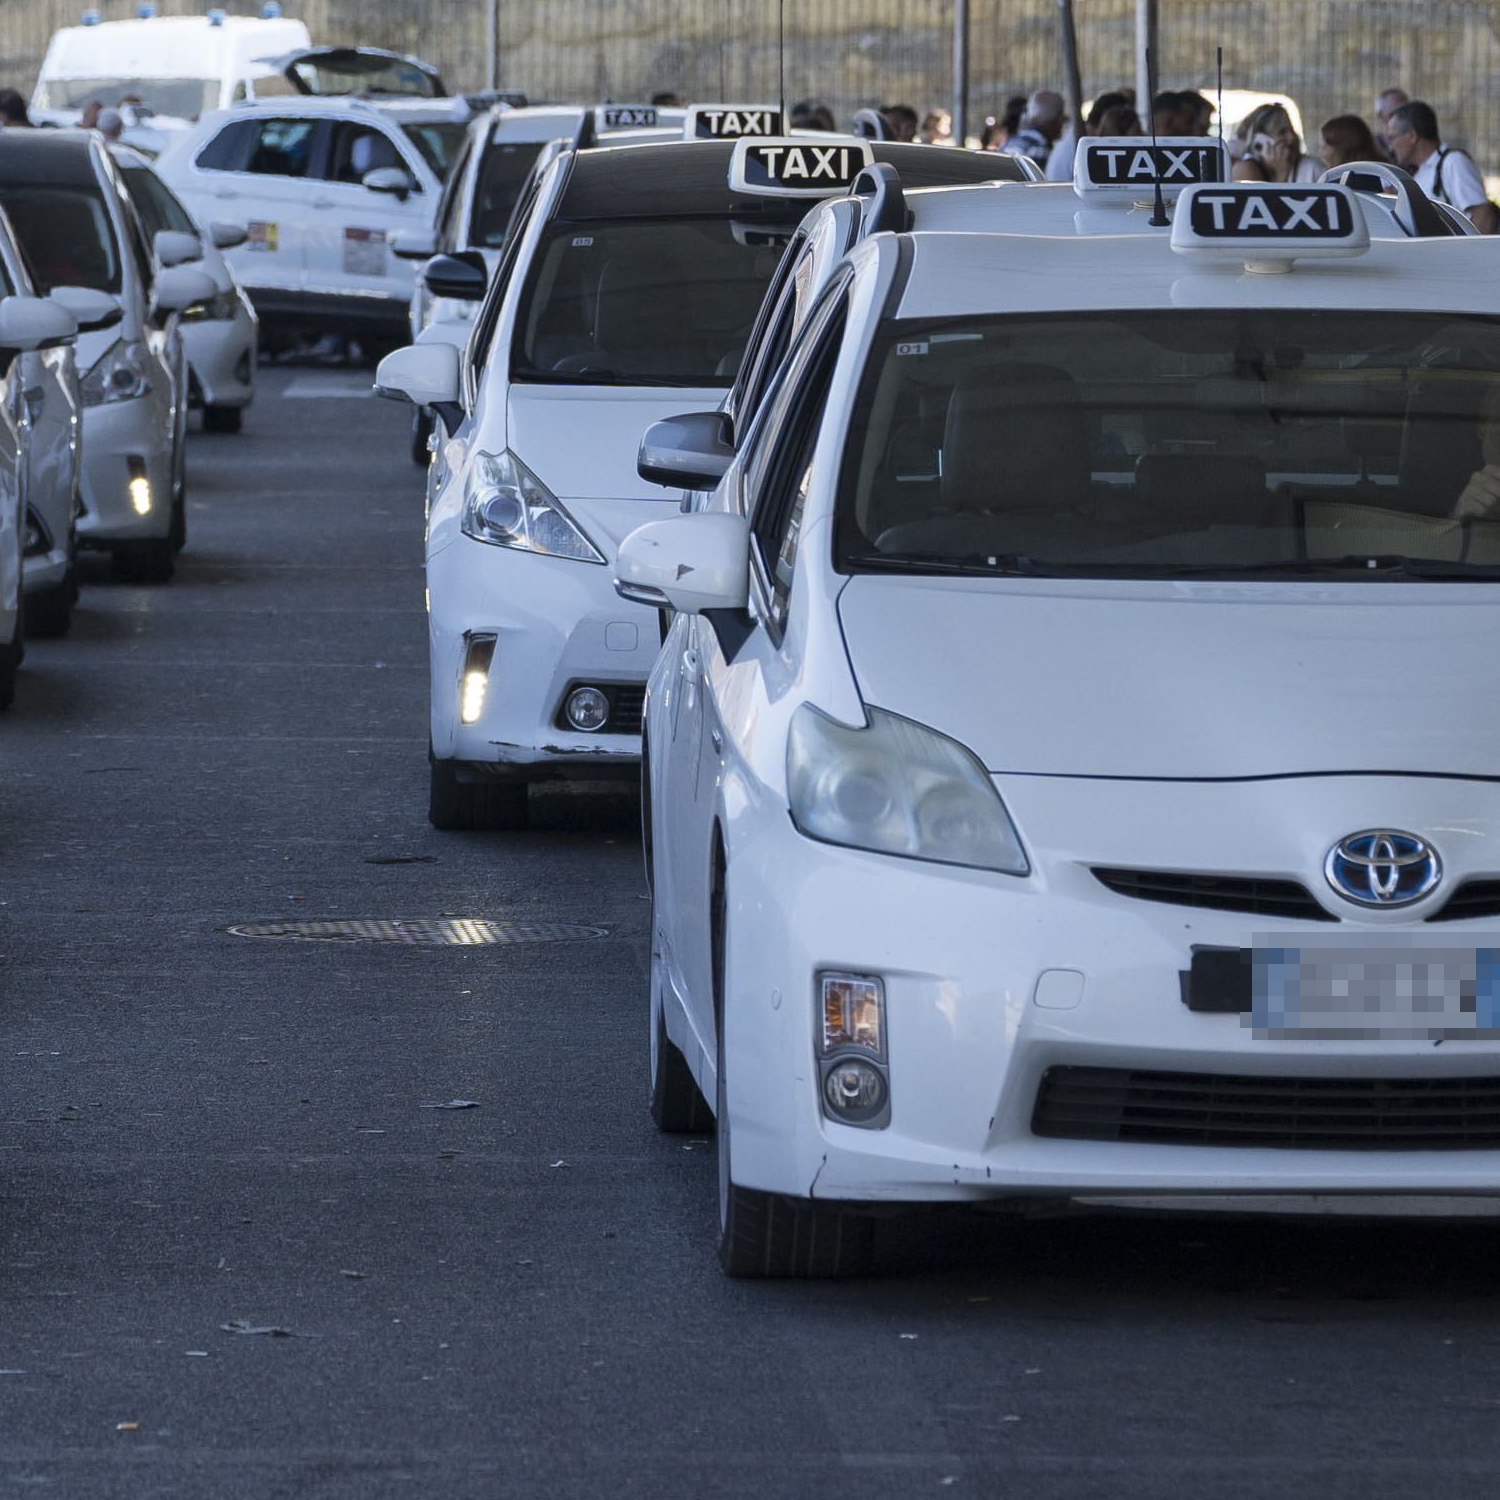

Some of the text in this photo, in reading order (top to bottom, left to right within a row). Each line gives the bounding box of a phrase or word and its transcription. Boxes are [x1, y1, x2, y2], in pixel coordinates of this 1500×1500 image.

[605, 110, 654, 125] TAXI
[705, 112, 772, 135] TAXI
[759, 148, 849, 179] TAXI
[1198, 197, 1339, 230] TAXI
[899, 344, 921, 354] 01
